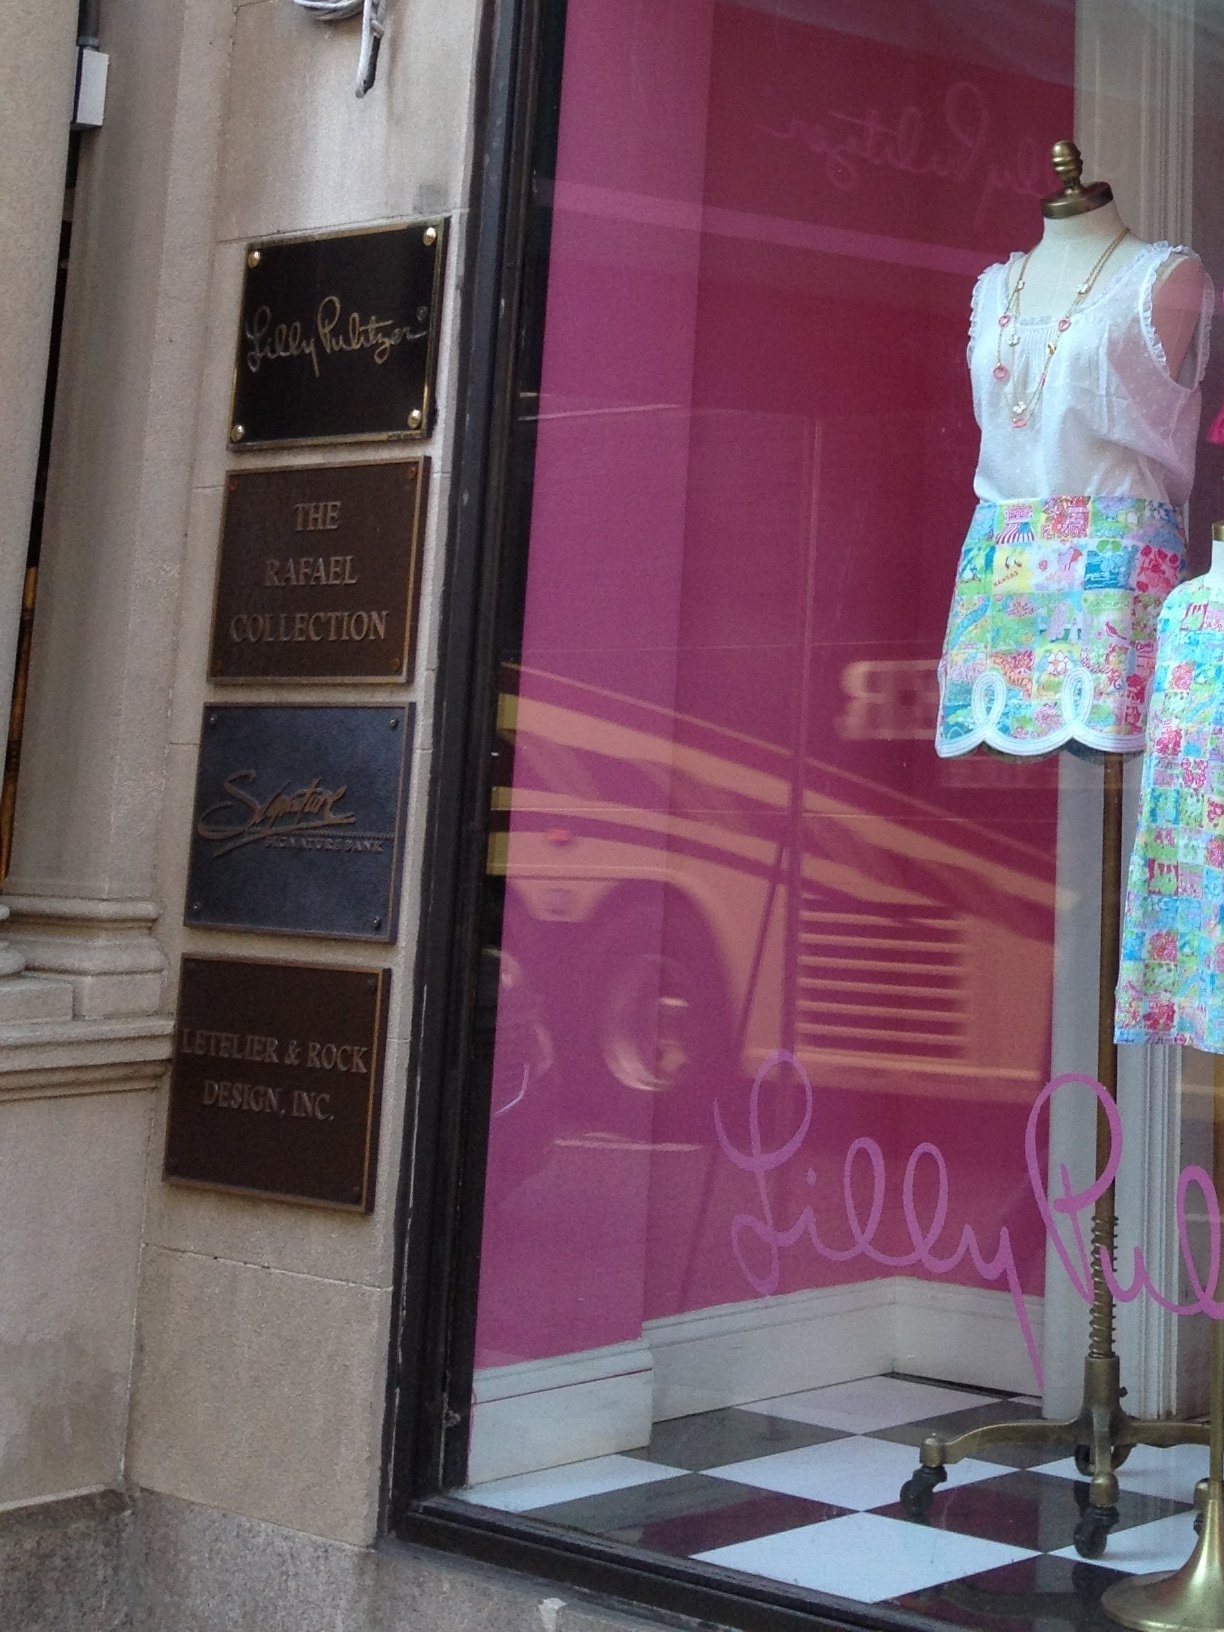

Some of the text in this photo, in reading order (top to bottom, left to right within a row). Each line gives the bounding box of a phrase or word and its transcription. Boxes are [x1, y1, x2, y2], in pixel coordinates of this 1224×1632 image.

[245, 305, 320, 378] Lilly
[293, 500, 343, 532] THE
[263, 555, 360, 587] RAFAEL
[229, 610, 389, 643] COLLECTION
[180, 1028, 369, 1074] LETELIER & ROCK
[202, 1079, 335, 1122] DESIGN, INC.
[713, 1050, 1044, 1397] Lilly
